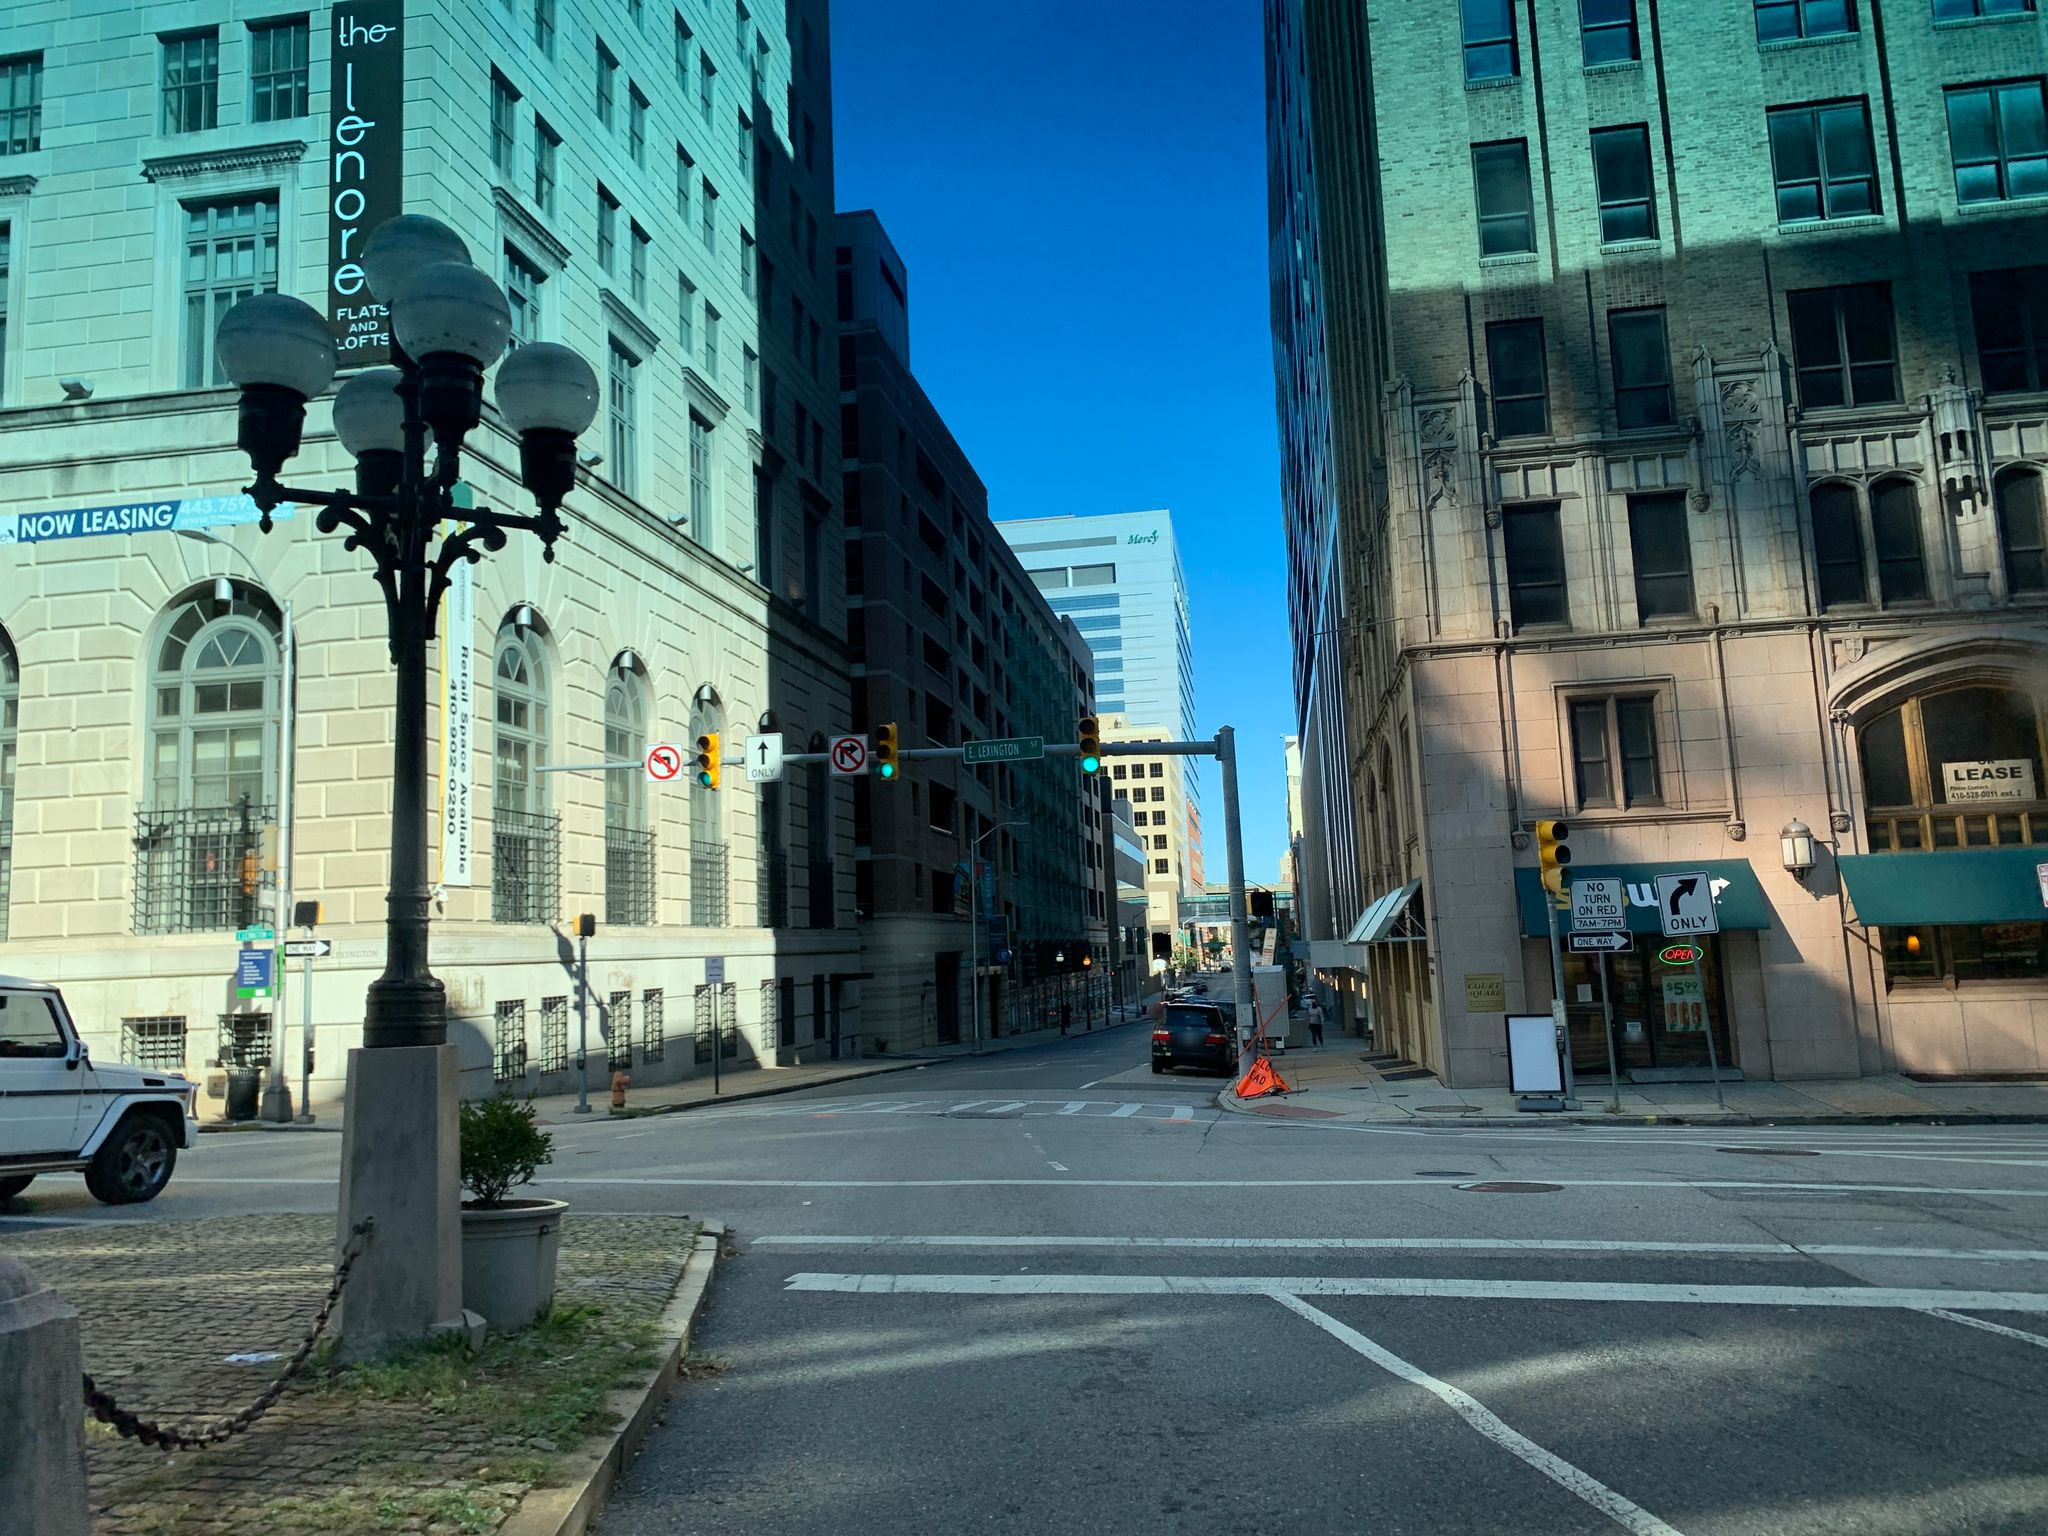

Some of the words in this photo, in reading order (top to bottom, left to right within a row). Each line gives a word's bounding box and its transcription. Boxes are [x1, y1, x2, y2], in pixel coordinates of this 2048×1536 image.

[339, 15, 397, 47] the
[334, 62, 376, 296] lenore
[337, 304, 390, 321] FLATS
[349, 320, 379, 333] AND
[336, 333, 390, 351] LOFTS
[20, 513, 78, 538] NOW
[82, 504, 174, 533] LEASING
[1127, 532, 1160, 545] Mercy
[460, 645, 469, 703] Retail
[460, 711, 469, 774] Space
[978, 743, 1019, 758] LEXINGTON
[1030, 740, 1038, 748] ST
[447, 678, 458, 836] 410-902-0290
[751, 767, 776, 779] ONLY
[1953, 766, 2023, 782] LEASE
[458, 783, 468, 875] Available
[1587, 882, 1605, 892] NO
[1583, 894, 1611, 904] TURN
[1578, 906, 1593, 916] ON
[1597, 905, 1618, 915] RED
[1576, 918, 1622, 928] 7AM-7PM
[1670, 916, 1708, 930] ONLY
[288, 944, 300, 953] ONE
[302, 944, 316, 952] WAY
[1577, 937, 1593, 946] ONE
[1595, 937, 1614, 946] WAY
[1467, 982, 1501, 990] COURT
